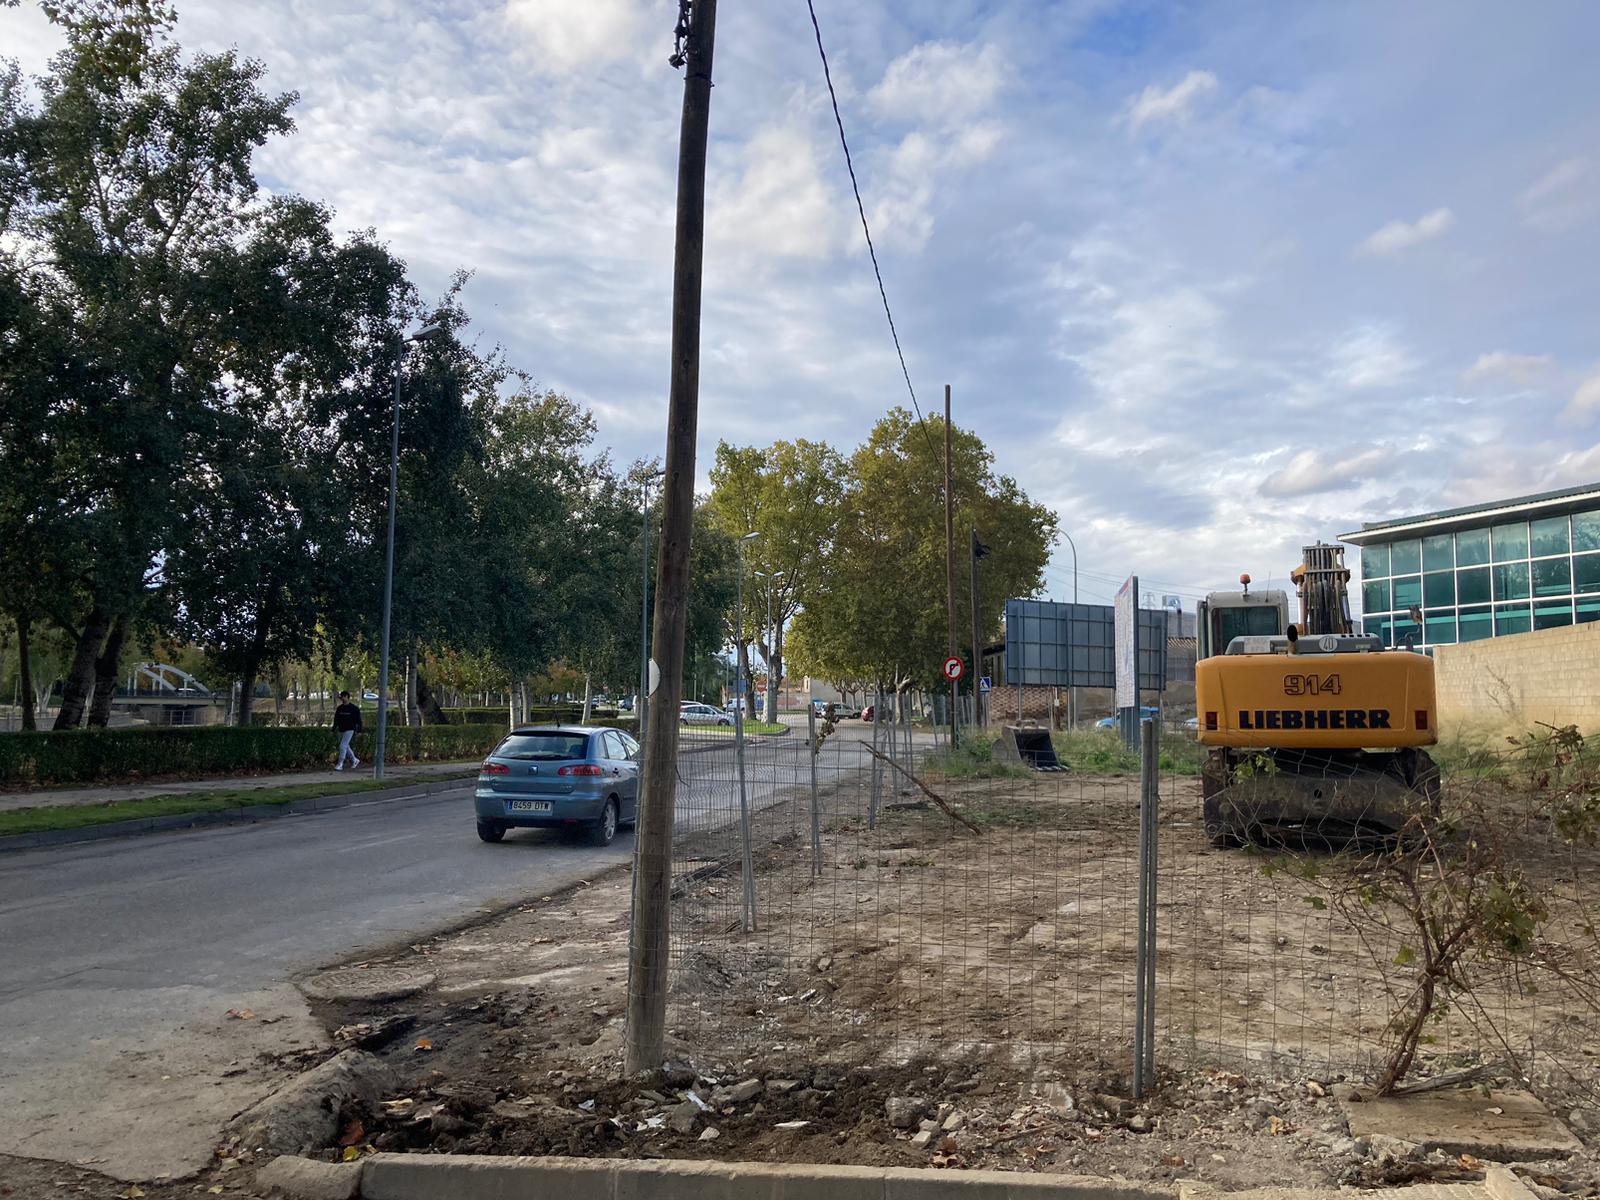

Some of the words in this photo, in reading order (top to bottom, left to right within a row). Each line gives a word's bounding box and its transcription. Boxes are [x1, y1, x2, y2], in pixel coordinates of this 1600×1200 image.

[1283, 674, 1342, 696] 914
[1239, 709, 1392, 729] LIEBHERR
[513, 801, 532, 810] 8459
